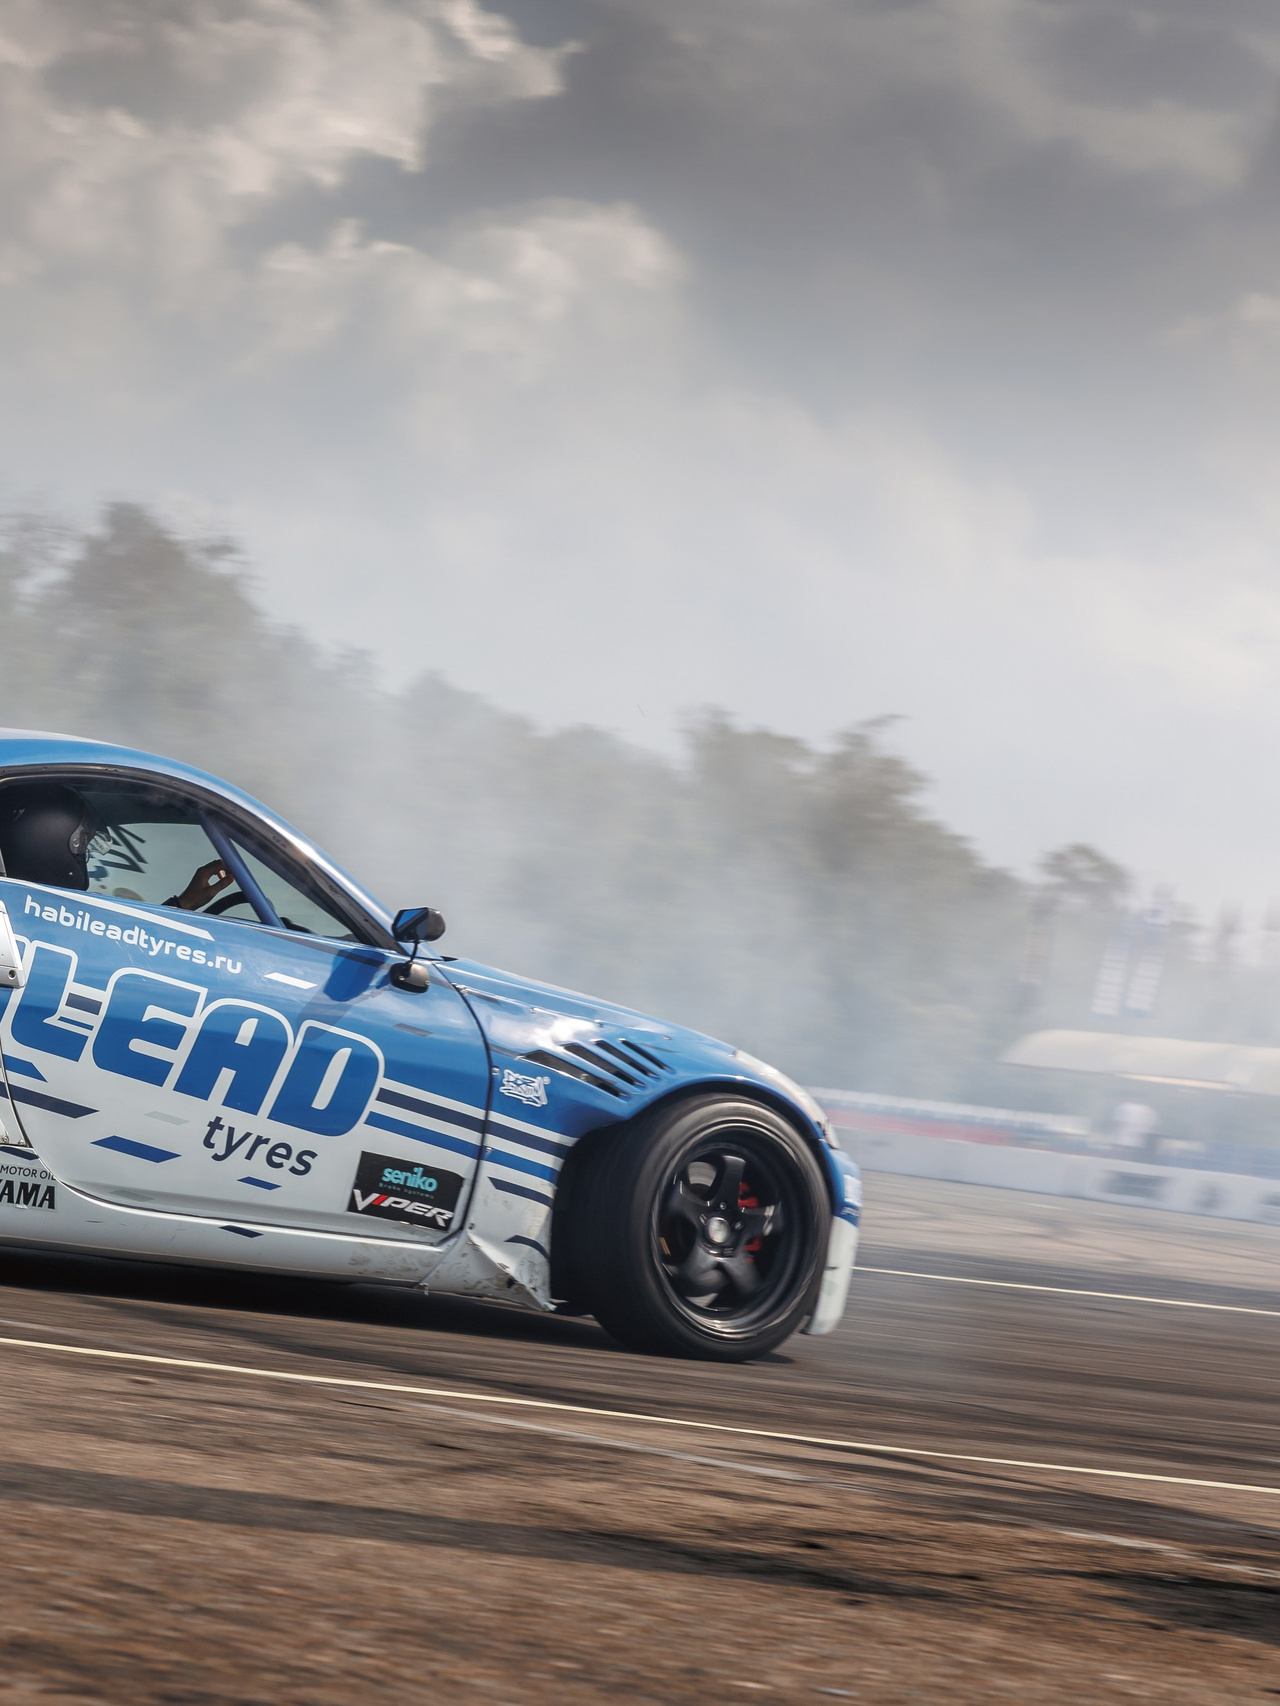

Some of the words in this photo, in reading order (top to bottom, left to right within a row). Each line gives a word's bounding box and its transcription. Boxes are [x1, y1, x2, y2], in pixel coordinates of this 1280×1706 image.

[24, 894, 242, 974] habileadtyres.ru
[202, 1115, 318, 1176] tyres
[0, 1164, 37, 1178] MOTOR
[381, 1167, 437, 1192] seniko
[352, 1188, 454, 1227] VIPER
